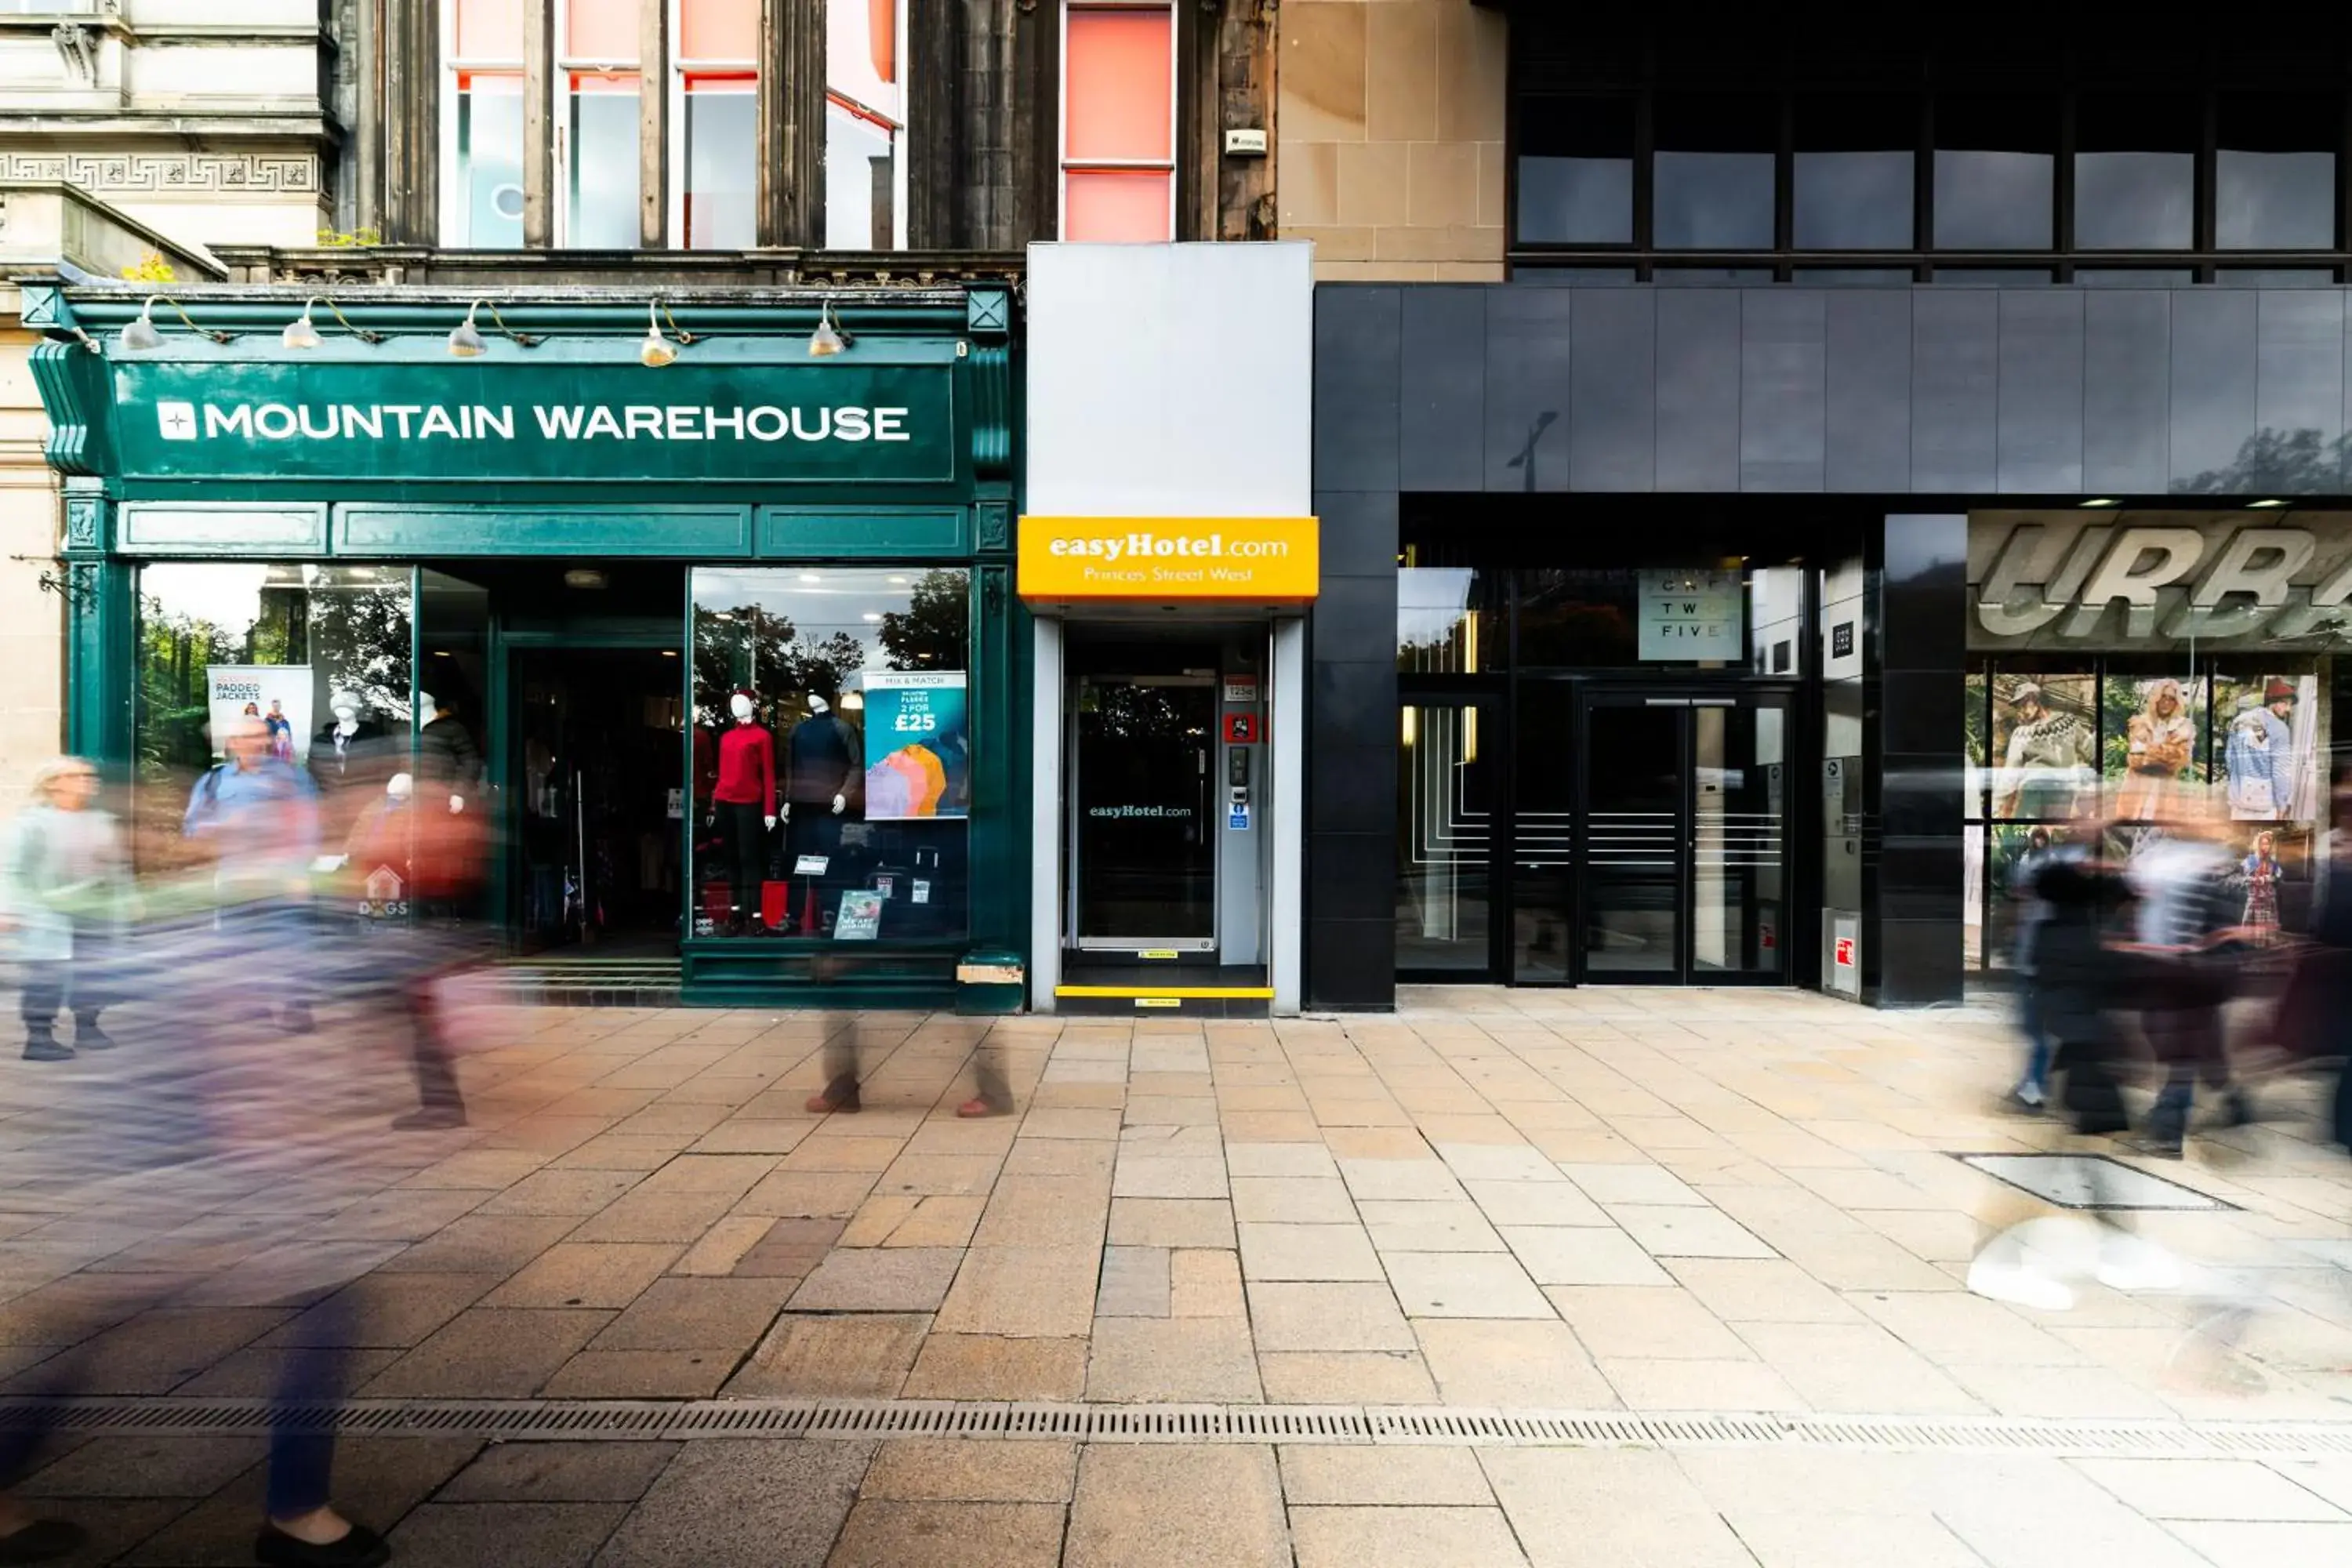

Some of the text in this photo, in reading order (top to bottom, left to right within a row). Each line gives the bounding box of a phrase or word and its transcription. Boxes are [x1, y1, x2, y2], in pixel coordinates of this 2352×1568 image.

[203, 403, 910, 441] MOUNTAIN WAREHOUSE
[1049, 533, 1289, 561] easyHotel.com
[1084, 568, 1253, 582] Princes Street West
[1663, 626, 1719, 637] FIVE
[216, 683, 260, 691] PADDED
[909, 704, 929, 713] FOR
[895, 713, 936, 731] £25
[1089, 804, 1192, 818] easyHotel.com
